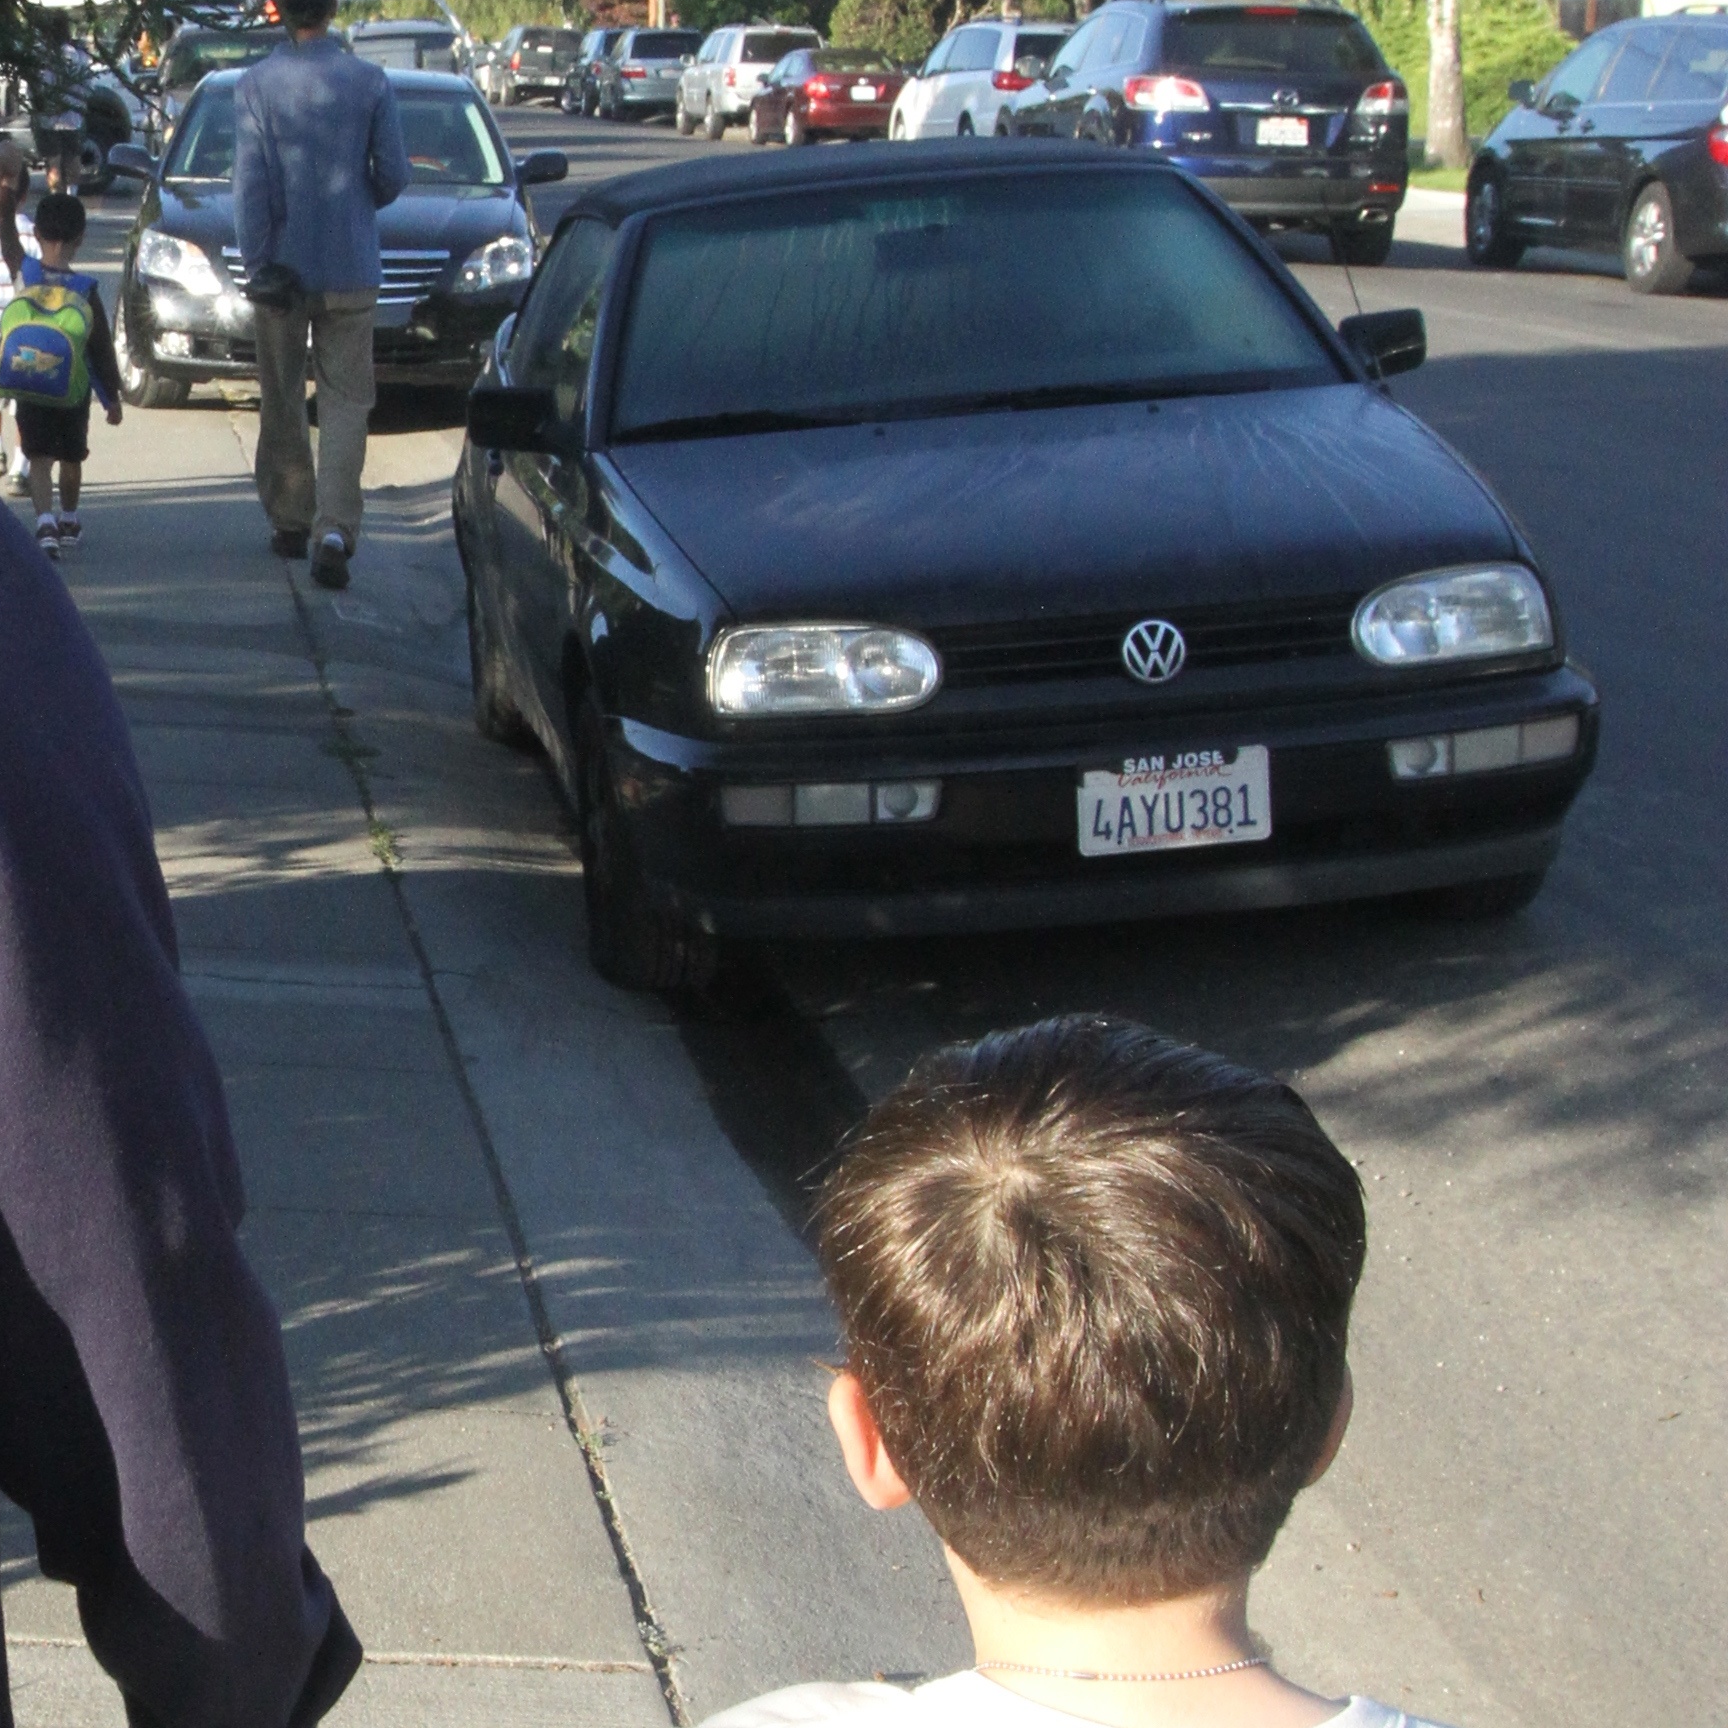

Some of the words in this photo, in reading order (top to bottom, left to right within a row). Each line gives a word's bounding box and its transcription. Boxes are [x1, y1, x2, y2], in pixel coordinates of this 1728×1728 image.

[1123, 755, 1165, 774] SAN
[1172, 750, 1225, 770] JOSE
[1092, 782, 1258, 844] 4AYU381
